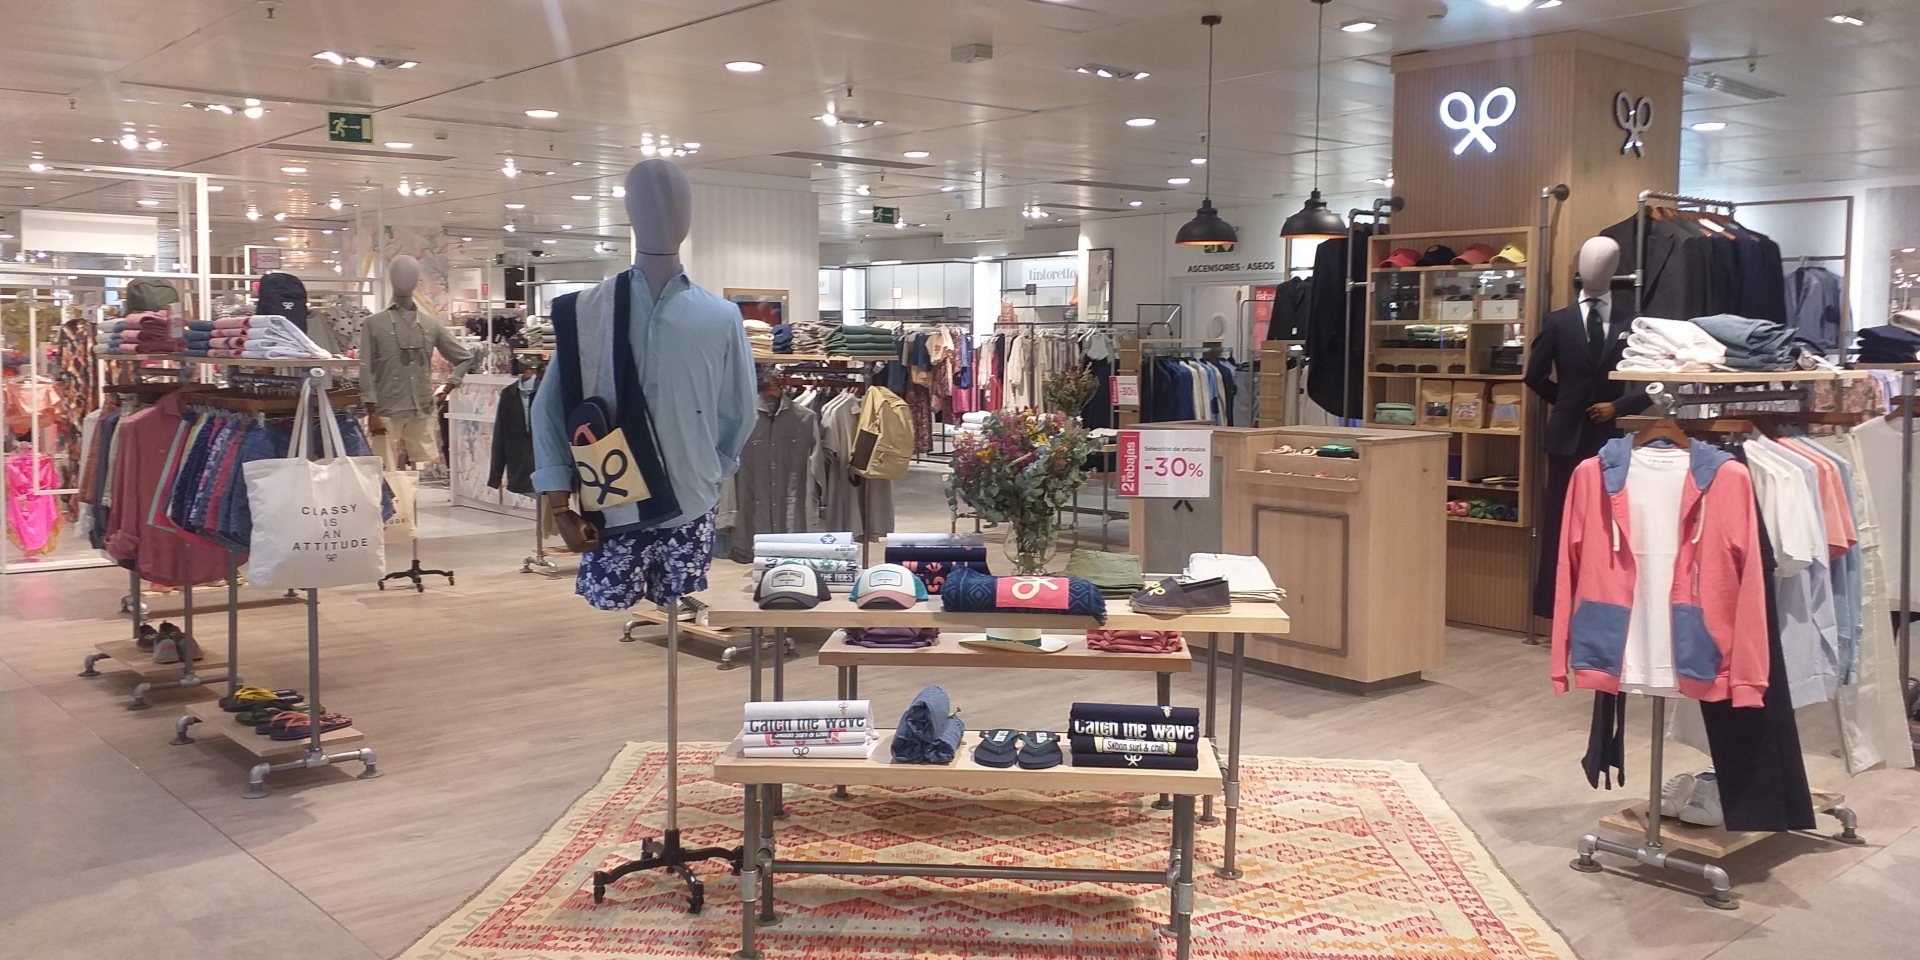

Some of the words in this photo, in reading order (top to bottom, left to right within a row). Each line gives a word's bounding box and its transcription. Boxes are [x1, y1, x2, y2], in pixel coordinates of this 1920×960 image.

[1187, 263, 1241, 273] ASCENSORES
[1247, 261, 1275, 271] ASEOS
[1029, 268, 1077, 281] tintoretto
[1123, 441, 1138, 482] rebajas
[1144, 457, 1203, 477] -30%
[301, 504, 357, 516] CLASSY
[323, 518, 338, 527] IS
[322, 530, 341, 539] AN
[292, 538, 368, 551] ATTITUDE
[825, 717, 865, 729] wave
[1150, 724, 1195, 741] wave
